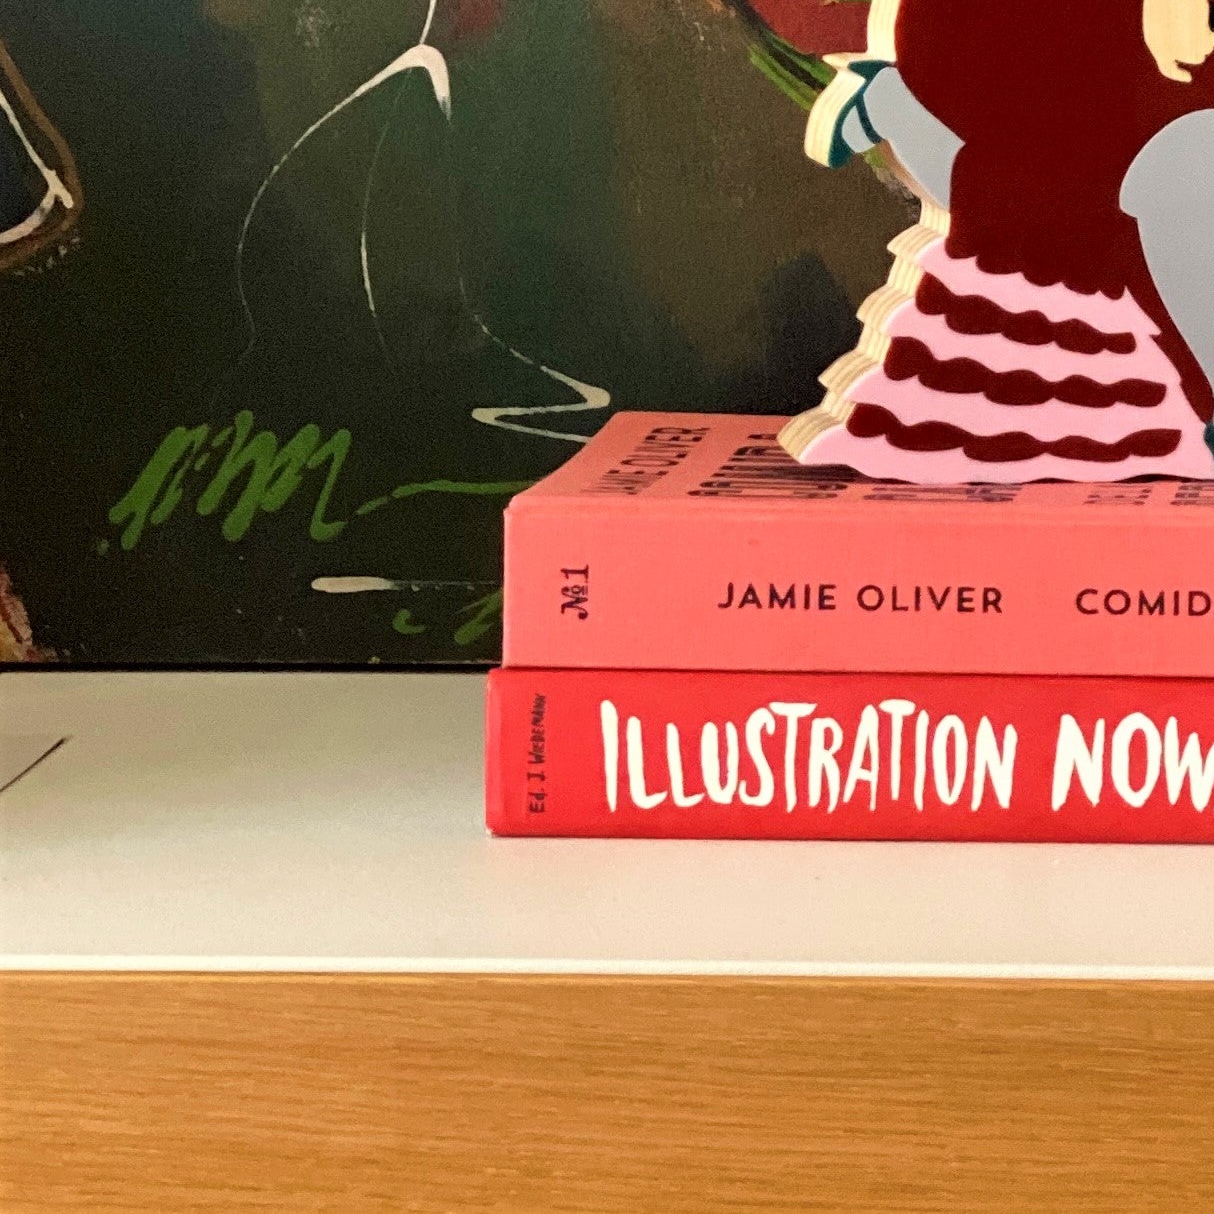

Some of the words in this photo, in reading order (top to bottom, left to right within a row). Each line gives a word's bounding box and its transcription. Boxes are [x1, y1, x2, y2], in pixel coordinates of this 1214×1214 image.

[620, 426, 710, 467] OLIVER
[717, 582, 837, 611] JAMIE
[856, 584, 1003, 614] OLIVER
[600, 698, 1018, 813] ILLUSTRATION
